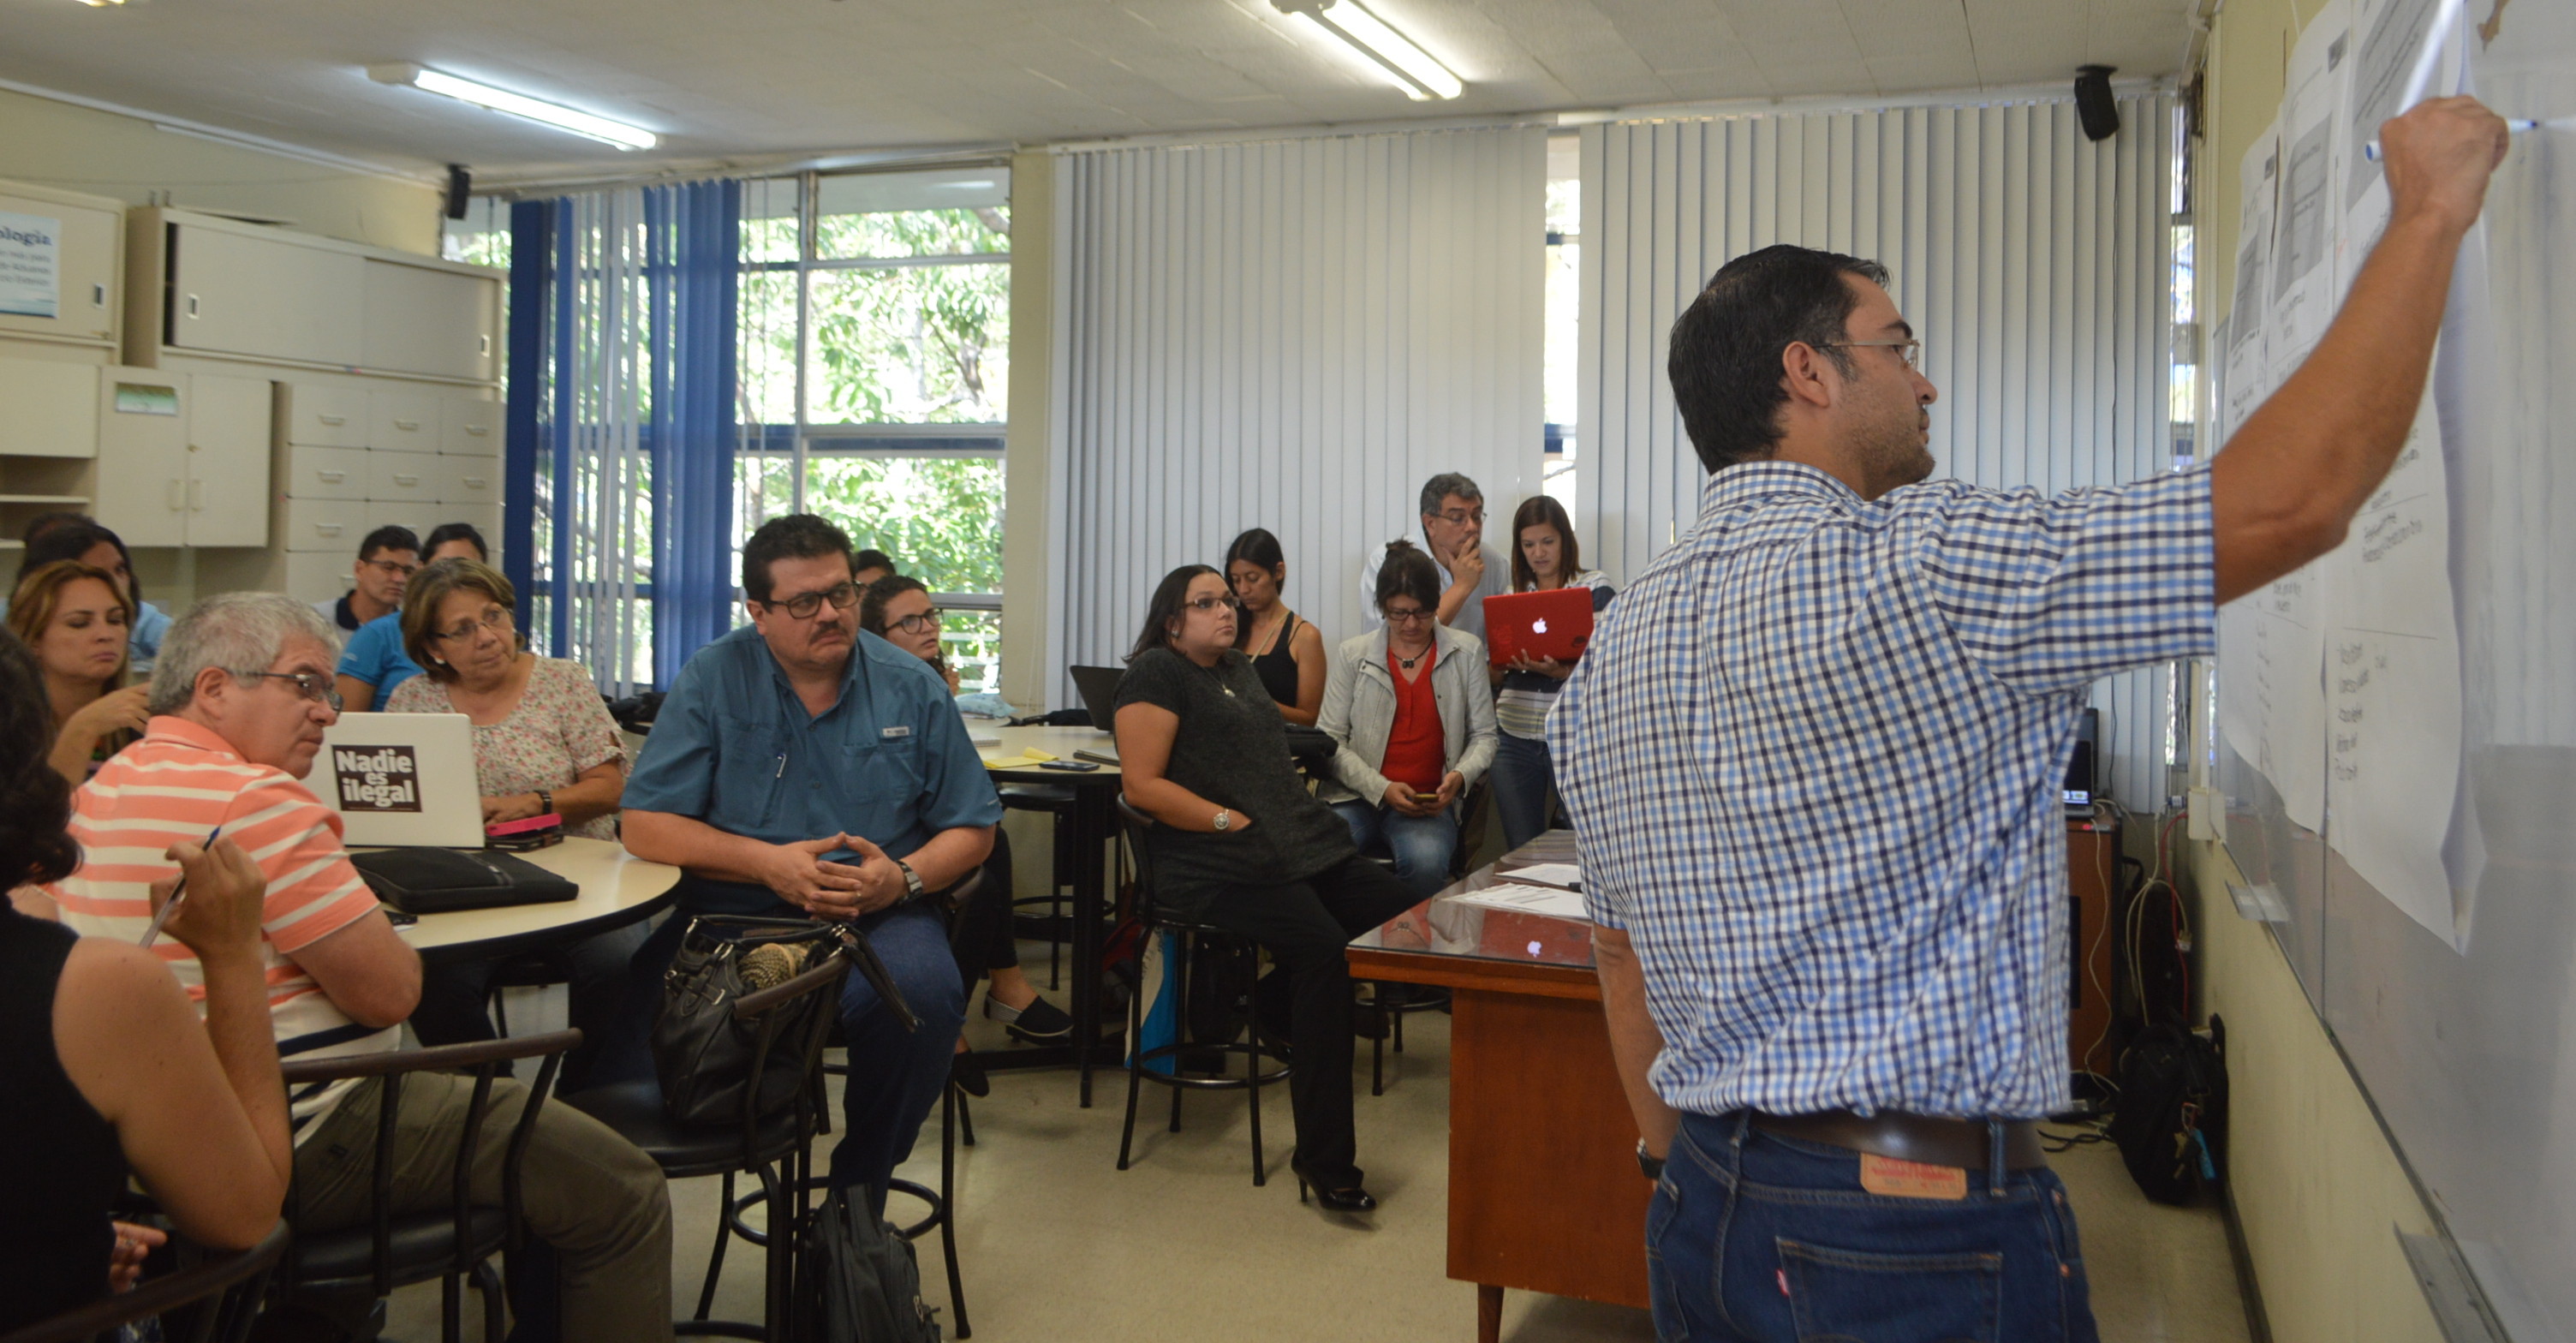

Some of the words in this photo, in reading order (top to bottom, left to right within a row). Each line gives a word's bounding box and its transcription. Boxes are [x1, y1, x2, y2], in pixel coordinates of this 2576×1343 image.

[336, 749, 413, 773] Nadie
[366, 773, 388, 785] es
[343, 778, 414, 807] ilegal
